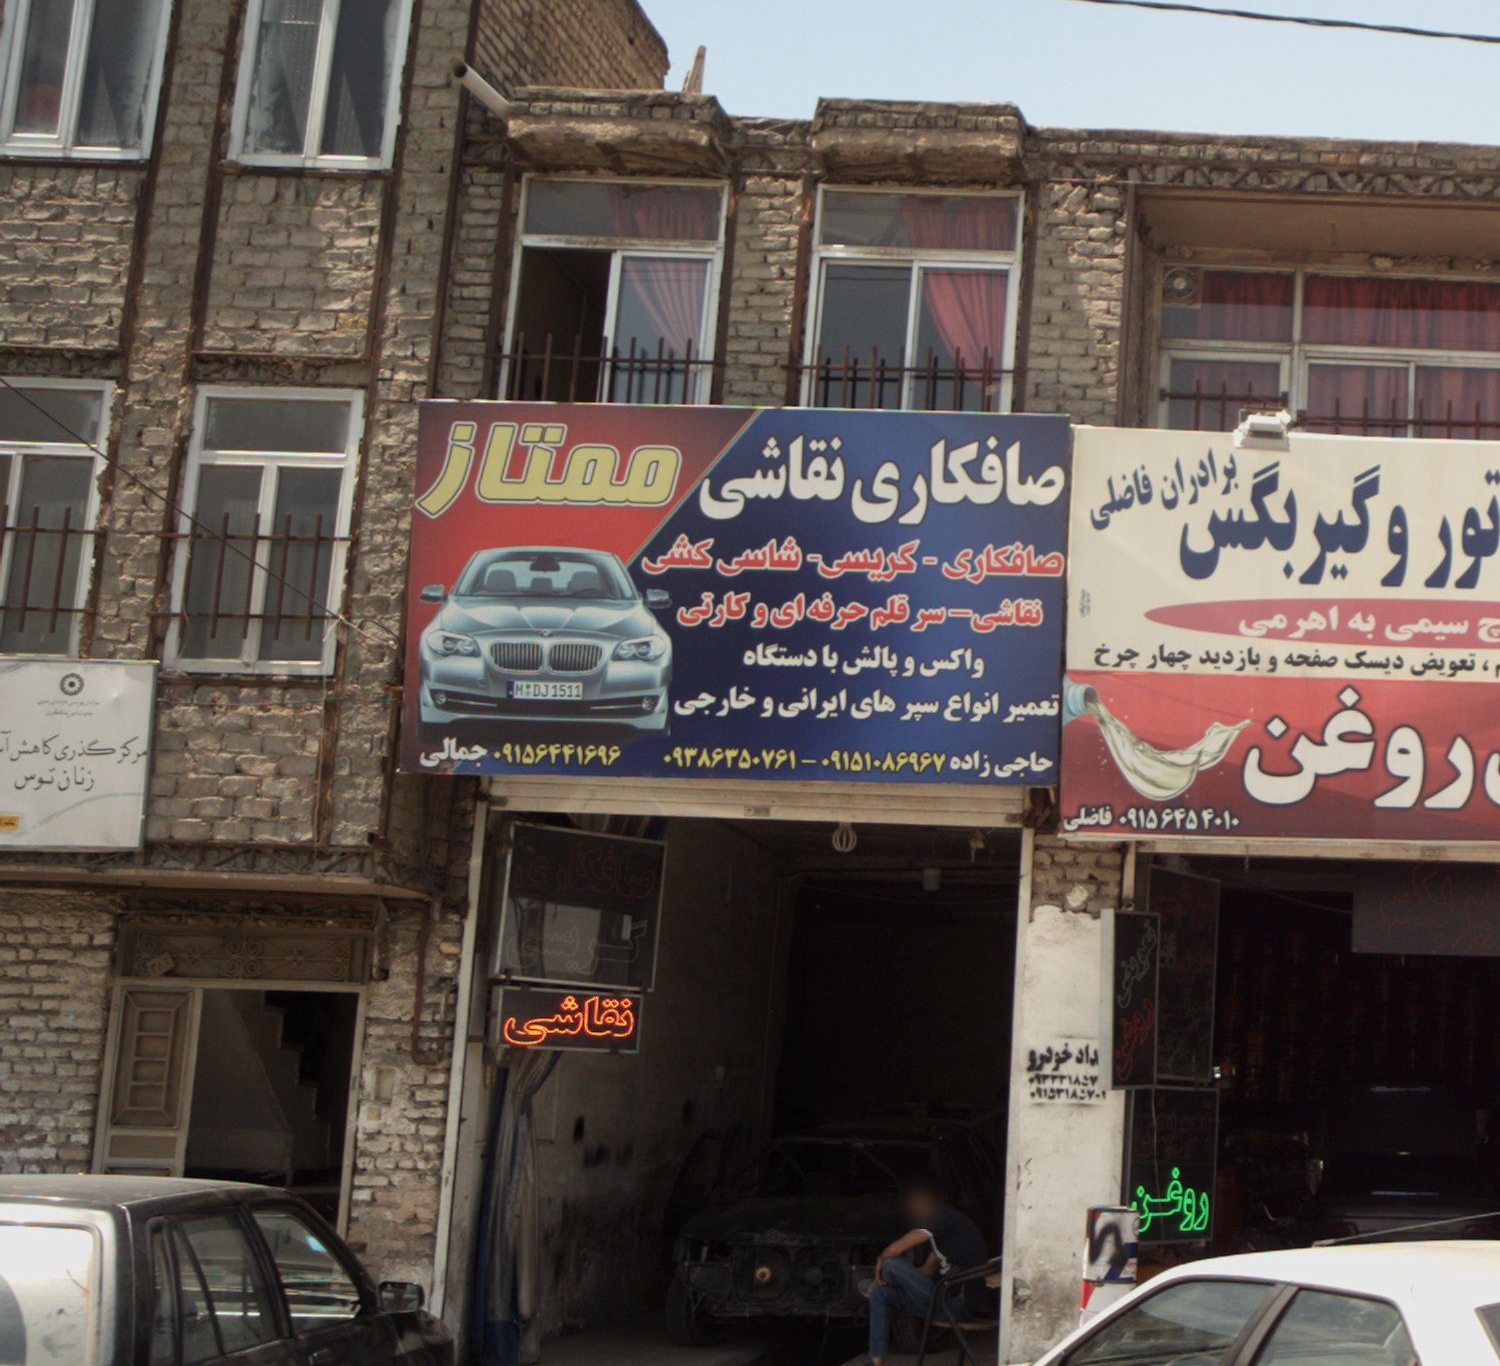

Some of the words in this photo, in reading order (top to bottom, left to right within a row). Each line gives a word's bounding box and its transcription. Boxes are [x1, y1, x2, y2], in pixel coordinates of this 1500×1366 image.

[415, 422, 682, 519] ممتاز
[699, 435, 845, 520] نقاشی
[851, 436, 1066, 524] صافکاری
[1161, 447, 1239, 511] برادران
[1090, 464, 1153, 531] فاضلی
[641, 533, 714, 575] کشی
[716, 536, 801, 576] شاسی
[942, 540, 1065, 584] صافکاری
[677, 591, 750, 627] کارتی
[751, 602, 768, 629] و
[870, 594, 910, 631] قلم
[910, 606, 946, 631] سر
[1239, 605, 1340, 638] اهرمی
[1347, 611, 1376, 639] به
[1385, 614, 1469, 642] سیمی
[743, 642, 818, 670] دستگاه
[822, 644, 839, 673] با
[842, 644, 898, 678] پالش
[901, 654, 915, 677] و
[919, 646, 985, 679] واکس
[1093, 644, 1140, 671] چرخ
[1147, 644, 1192, 671] چهار
[1199, 646, 1261, 672] بازدید
[1267, 654, 1278, 672] و
[1284, 648, 1339, 669] صفحه
[1344, 650, 1404, 675] دیسک
[1410, 652, 1476, 676] تعویض
[674, 687, 756, 718] خارجی
[762, 694, 774, 718] و
[777, 687, 847, 720] ایرانی
[850, 688, 897, 720] های
[900, 698, 940, 721] سپر
[943, 691, 1000, 722] انواع
[1002, 693, 1059, 723] تعمیر
[9, 734, 60, 762] کاهش
[54, 739, 116, 762] گذری
[117, 736, 149, 765] مرکز
[419, 736, 488, 768] جمالی
[492, 742, 622, 766] ۰۹۱۵۶۴۴۱۶۹۶
[662, 746, 797, 770] ۰۹۳۸۶۳۵۰۷۶۱
[821, 748, 945, 774] ۰۹۱۵۱۰۸۶۹۶۷
[1243, 685, 1475, 809] روغن
[950, 749, 991, 777] زاده
[993, 750, 1054, 777] حاجی
[14, 767, 56, 791] توس
[57, 765, 95, 792] زنان
[1063, 804, 1114, 831] فاضلی
[503, 995, 635, 1046] نقاشی
